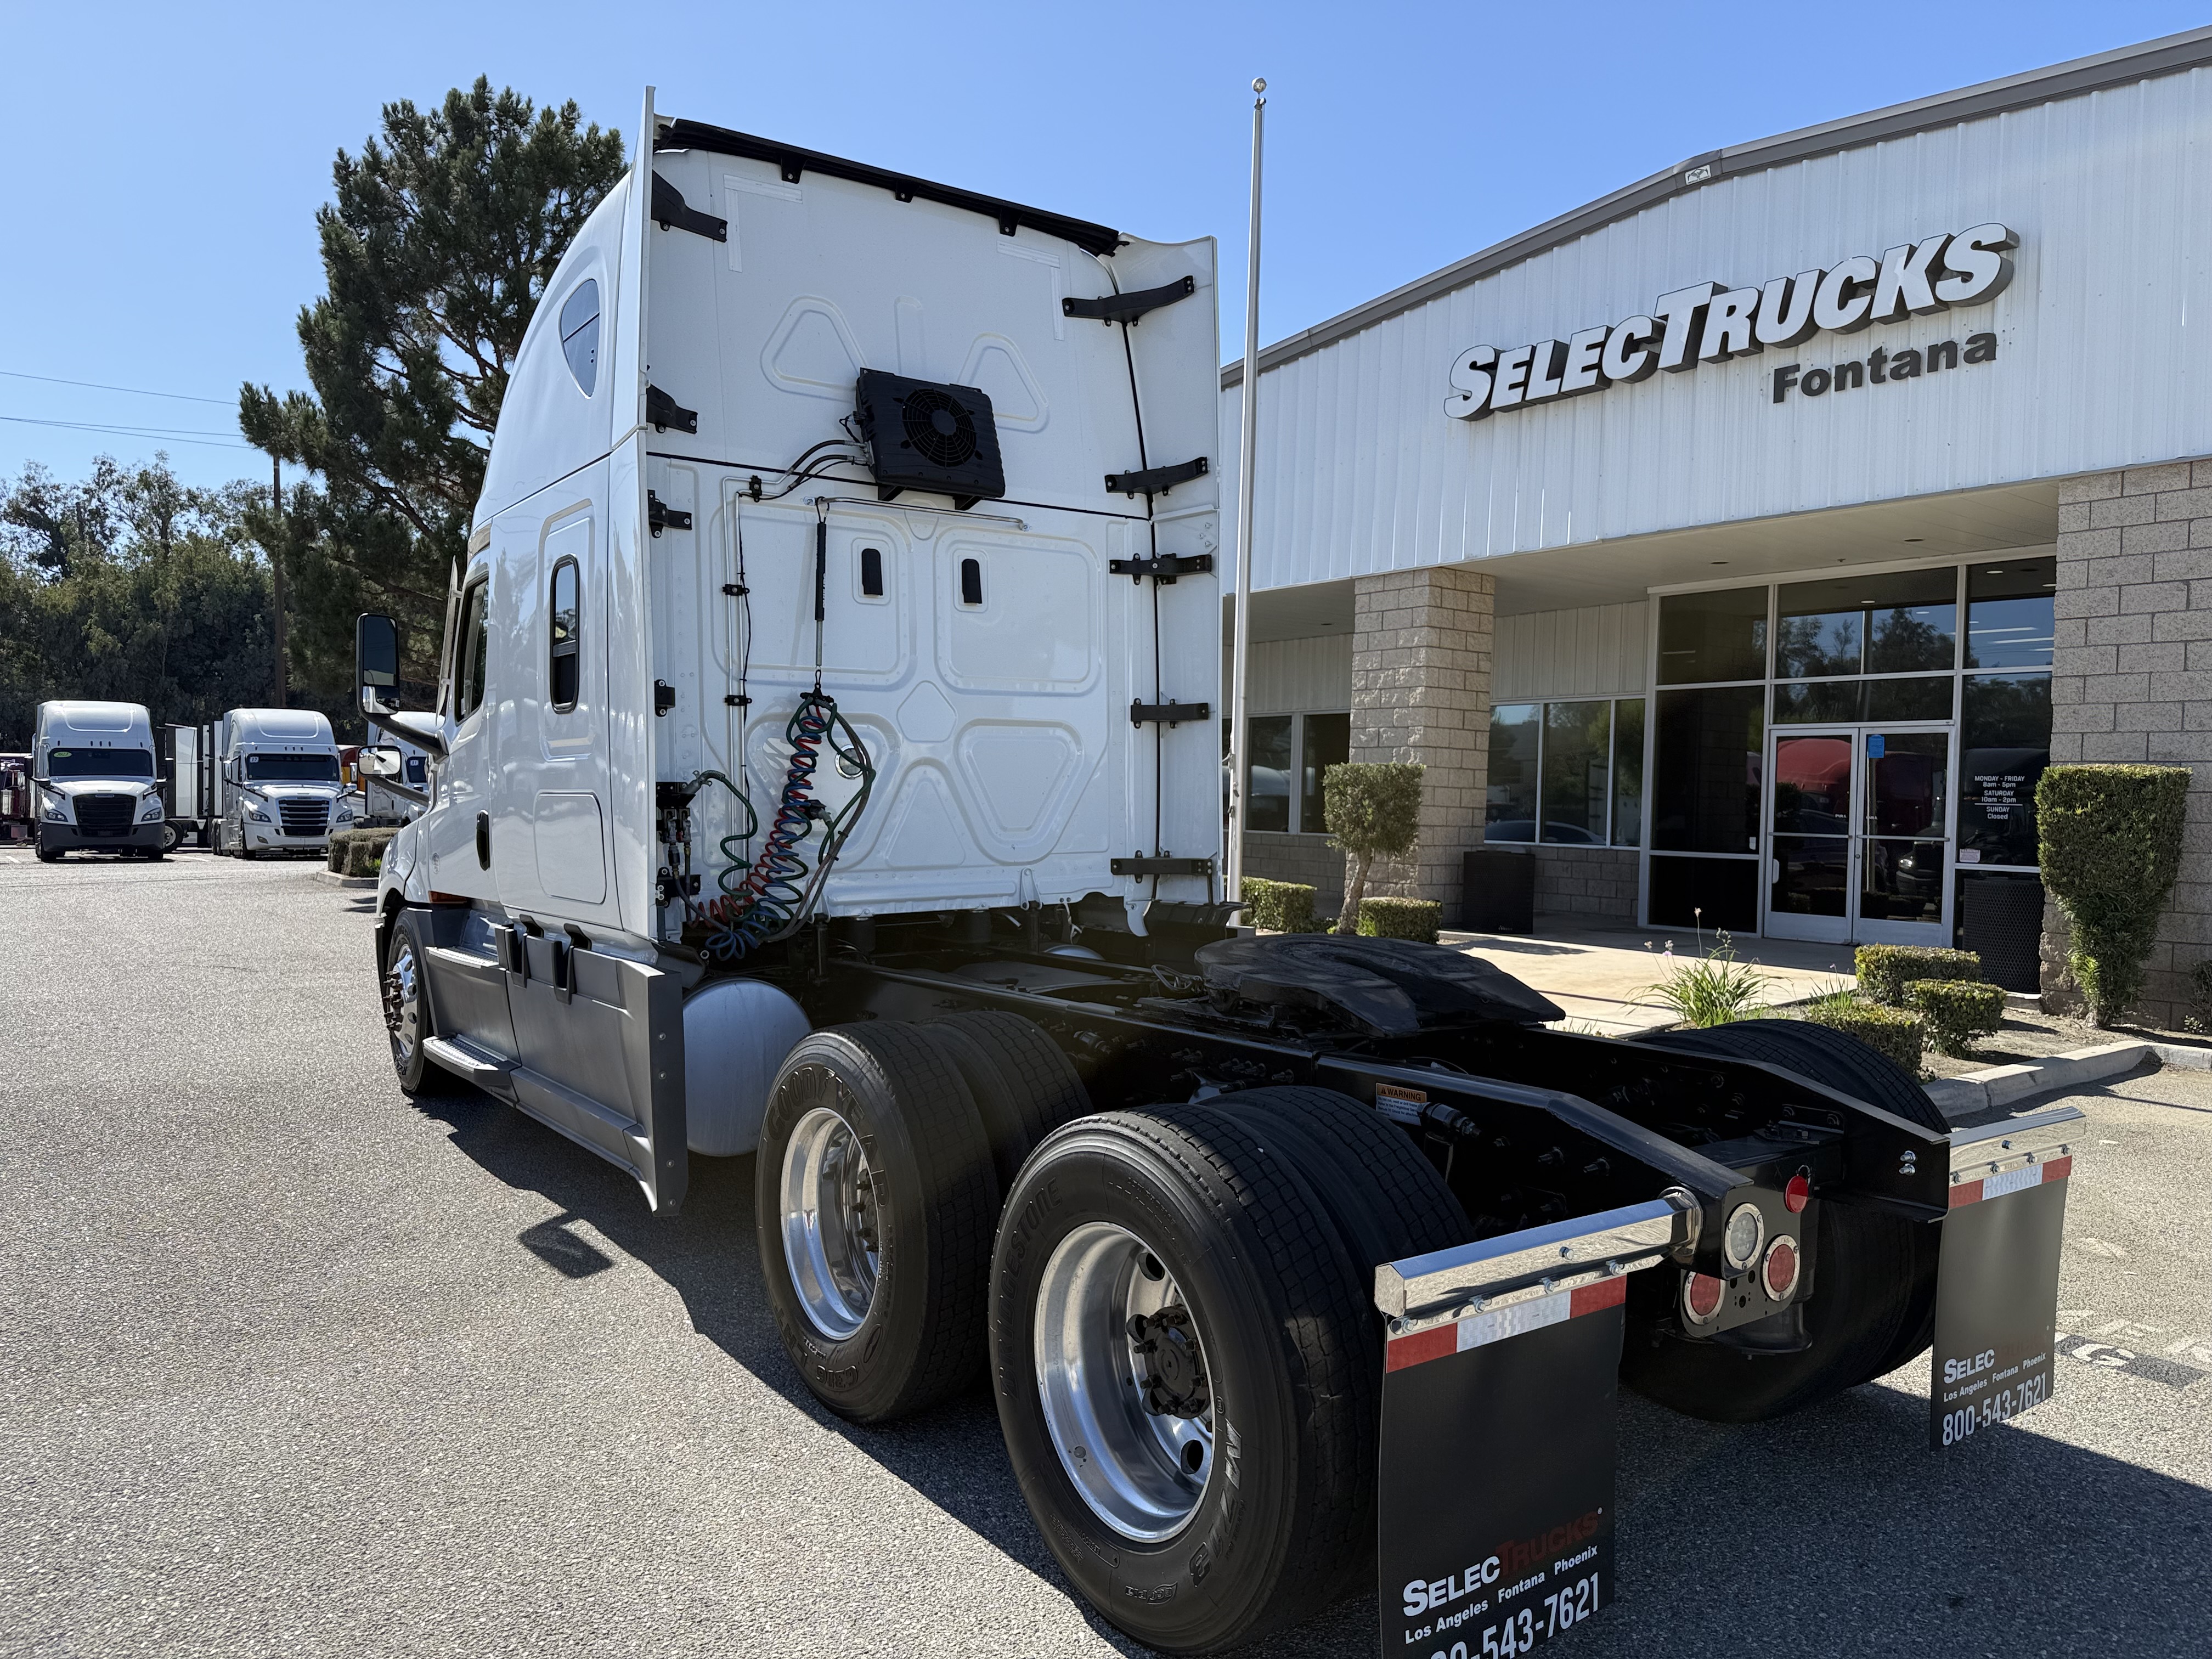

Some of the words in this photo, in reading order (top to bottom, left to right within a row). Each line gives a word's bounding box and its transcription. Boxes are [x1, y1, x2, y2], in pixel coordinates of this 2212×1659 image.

[1444, 222, 2019, 421] SELECTRUCKS
[1773, 331, 1997, 403] Fontana
[1387, 1087, 1421, 1101] WARNING
[997, 1176, 1065, 1402] BRIDGESTONE
[1942, 1372, 2046, 1446] 800-543-7621
[1943, 1391, 1957, 1402] Los
[1959, 1378, 1988, 1396] Angeles
[1992, 1365, 2018, 1383] Fontana
[2023, 1352, 2046, 1370] Phoenix
[1404, 1624, 1431, 1645] Los
[1435, 1599, 1488, 1633] Angeles
[1497, 1572, 1545, 1604] Fontana
[1554, 1545, 1598, 1576] Phoenix
[1430, 1571, 1599, 1659] -543-7621
